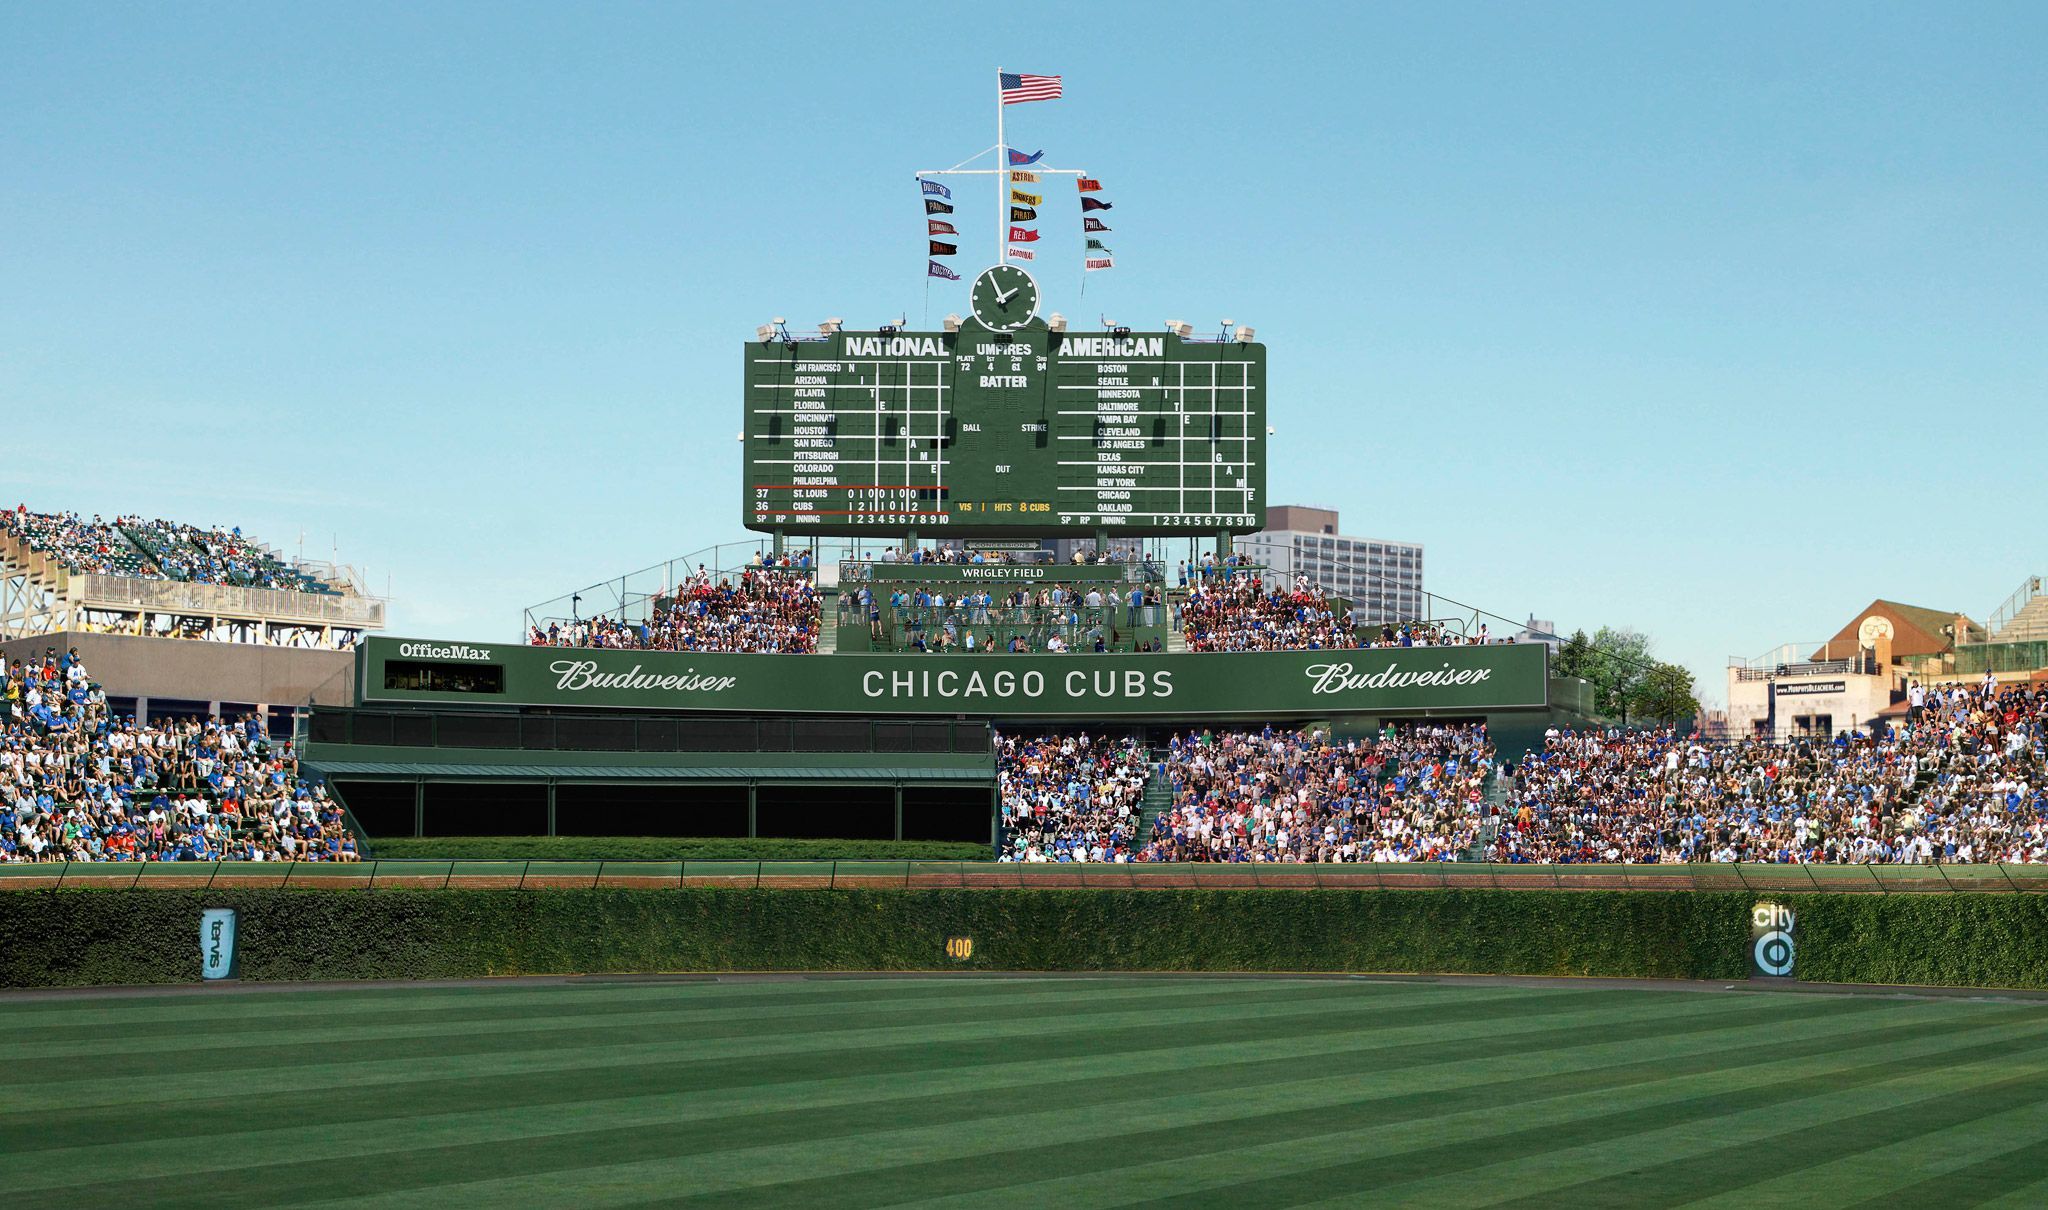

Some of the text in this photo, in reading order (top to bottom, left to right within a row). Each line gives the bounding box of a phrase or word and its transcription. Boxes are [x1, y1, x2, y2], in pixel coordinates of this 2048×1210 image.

[846, 337, 950, 356] NATIONAL
[976, 344, 1032, 356] UMPIRES
[1058, 338, 1164, 356] AMERICAN
[794, 363, 841, 372] SAN FRANCISCO
[849, 364, 855, 372] N
[961, 363, 970, 371] 72
[988, 363, 994, 372] 4
[1037, 363, 1046, 371] 84
[1098, 365, 1127, 373] BOSTON
[794, 376, 827, 385] ARIZONA
[980, 376, 1027, 388] BATTER
[1098, 377, 1128, 385] SEATTLE
[1152, 377, 1158, 386] N
[794, 389, 826, 397] ATLANTA
[870, 389, 875, 398] T
[1098, 390, 1140, 398] MINNESOTA
[794, 401, 826, 410] FLORIDA
[880, 401, 885, 410] E
[1098, 402, 1138, 411] BALTIMORE
[1174, 402, 1179, 411] T
[794, 414, 835, 422] CINCINNATI
[1098, 415, 1137, 424] TAMPA BAY
[1184, 415, 1190, 424] E
[794, 426, 828, 435] HOUSTON
[900, 426, 906, 436] G
[1098, 428, 1140, 436] CLEVELAND
[794, 439, 834, 448] SAN DIEGO
[910, 439, 917, 449] A
[1098, 440, 1145, 449] LOS ANGELES
[794, 452, 838, 460] PITTSBURGH
[920, 452, 928, 461] M
[1098, 453, 1121, 461] TEXAS
[1216, 453, 1222, 462] G
[793, 464, 834, 473] COLORADO
[931, 464, 936, 473] E
[1097, 466, 1144, 474] KANSAS CITY
[1226, 466, 1232, 475] A
[793, 477, 838, 485] PHILADELPHIA
[1097, 478, 1136, 487] NEW YORK
[1236, 479, 1244, 488] M
[756, 489, 768, 498] 37
[793, 489, 804, 497] ST.
[806, 489, 828, 498] LOUIS
[848, 489, 854, 498] 0
[868, 489, 874, 498] 0
[879, 489, 885, 498] 0
[899, 489, 905, 498] 0
[910, 489, 916, 498] 0
[1098, 491, 1130, 499] CHICAGO
[1248, 491, 1254, 501] E
[756, 502, 768, 511] 36
[793, 502, 813, 510] CUBS
[858, 502, 864, 511] 2
[890, 502, 896, 511] 0
[912, 502, 918, 511] 2
[959, 503, 972, 511] VIS
[995, 503, 1012, 511] HITS
[1020, 503, 1027, 512] 8
[1030, 503, 1050, 512] CUBS
[1098, 504, 1132, 512] OAKLAND
[796, 515, 820, 523] INNING
[857, 515, 864, 524] 2
[868, 515, 874, 524] 3
[878, 515, 885, 524] 4
[888, 515, 895, 524] 5
[899, 515, 906, 524] 6
[909, 515, 915, 524] 7
[920, 515, 926, 524] 8
[930, 515, 936, 524] 9
[939, 515, 949, 524] 10
[1061, 516, 1071, 524] SP
[1080, 516, 1090, 524] RP
[1102, 516, 1126, 525] INNING
[1163, 516, 1169, 526] 2
[1174, 516, 1180, 526] 3
[1184, 516, 1190, 526] 4
[1194, 516, 1201, 526] 5
[1205, 516, 1211, 526] 6
[1215, 516, 1222, 526] 7
[1226, 516, 1233, 526] 8
[1237, 516, 1243, 526] 9
[1246, 516, 1255, 526] 10
[962, 568, 1044, 577] WRIGLEY FIELD
[400, 643, 490, 660] OfficeMax
[550, 660, 736, 692] Budweiser
[1305, 662, 1491, 695] Budweiser
[863, 670, 1173, 698] CHICAGO CUBS
[1754, 904, 1796, 932] city
[210, 920, 224, 968] tervis
[946, 939, 972, 957] 400
